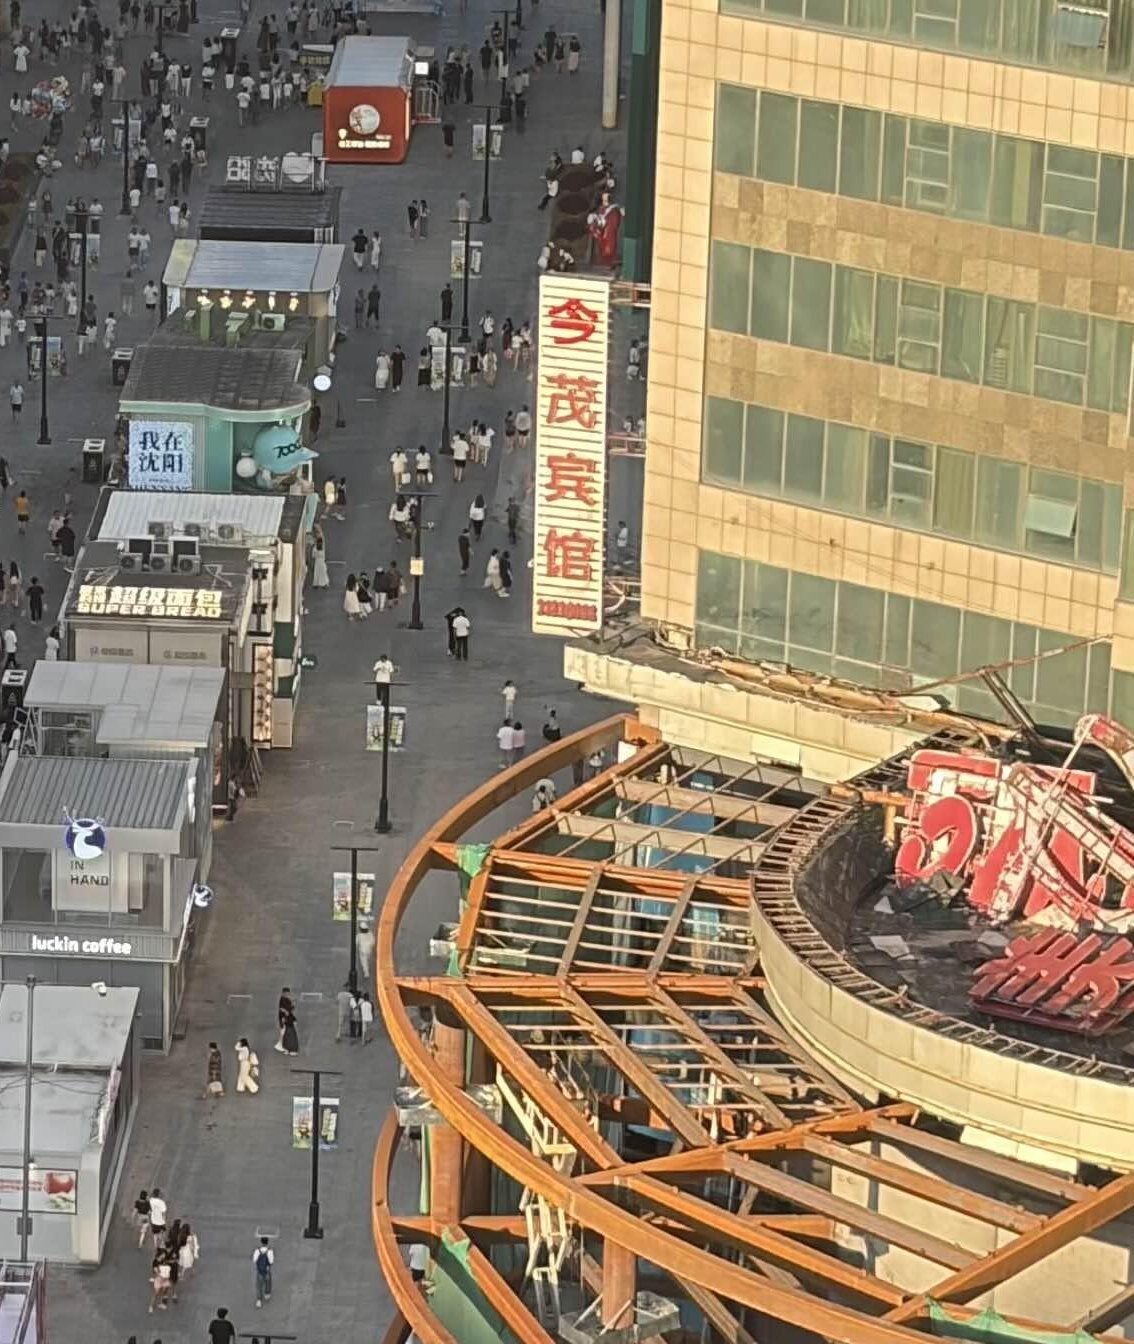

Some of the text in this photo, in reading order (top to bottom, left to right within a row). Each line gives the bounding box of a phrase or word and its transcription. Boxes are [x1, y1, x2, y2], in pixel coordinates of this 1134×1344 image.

[138, 430, 184, 452] 我在
[543, 297, 599, 583] 今茂宾馆
[138, 452, 184, 474] 沈阳
[70, 874, 109, 887] HAND
[31, 934, 133, 956] luckin coffee
